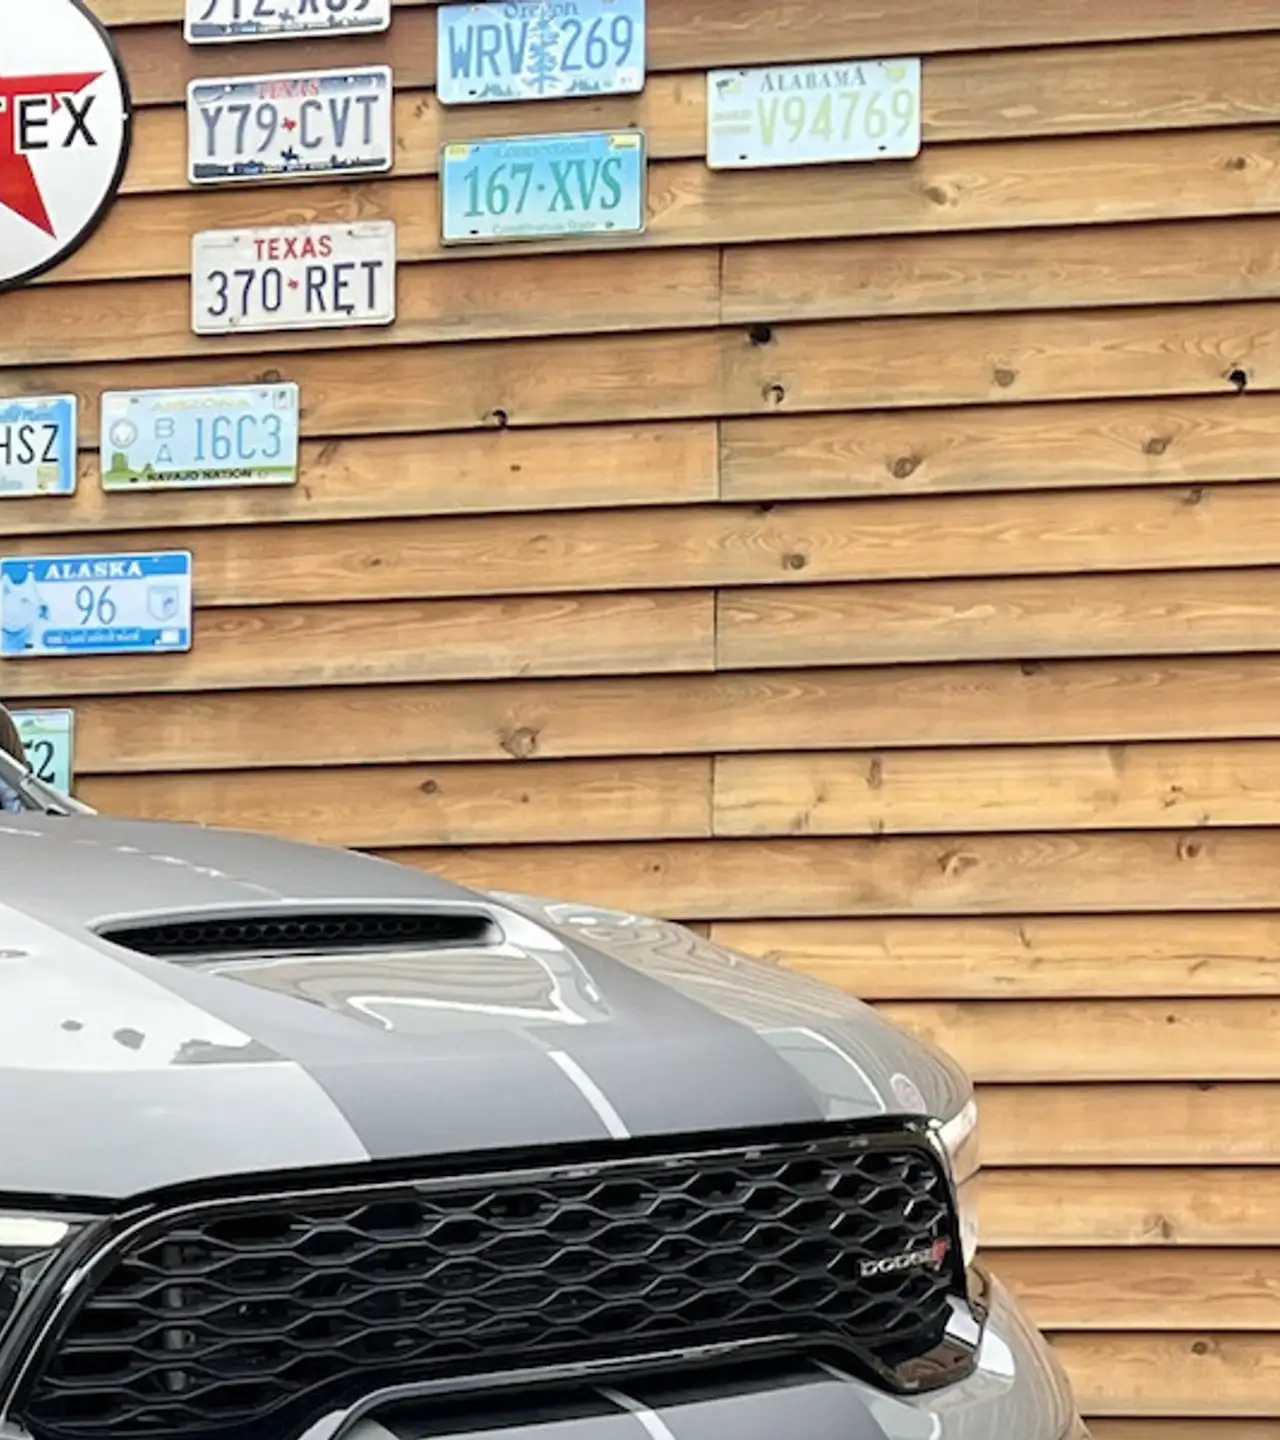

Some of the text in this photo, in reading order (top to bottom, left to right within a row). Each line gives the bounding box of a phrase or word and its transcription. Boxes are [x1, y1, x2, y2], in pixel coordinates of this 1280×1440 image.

[258, 80, 321, 98] TEXAS
[760, 66, 867, 92] ALABAMA
[756, 88, 915, 147] V94769
[254, 235, 333, 261] TEXAS
[194, 413, 282, 461] 16C3
[147, 469, 252, 482] NAVAJO NATION
[44, 560, 142, 580] ALASKA
[75, 585, 117, 625] 96
